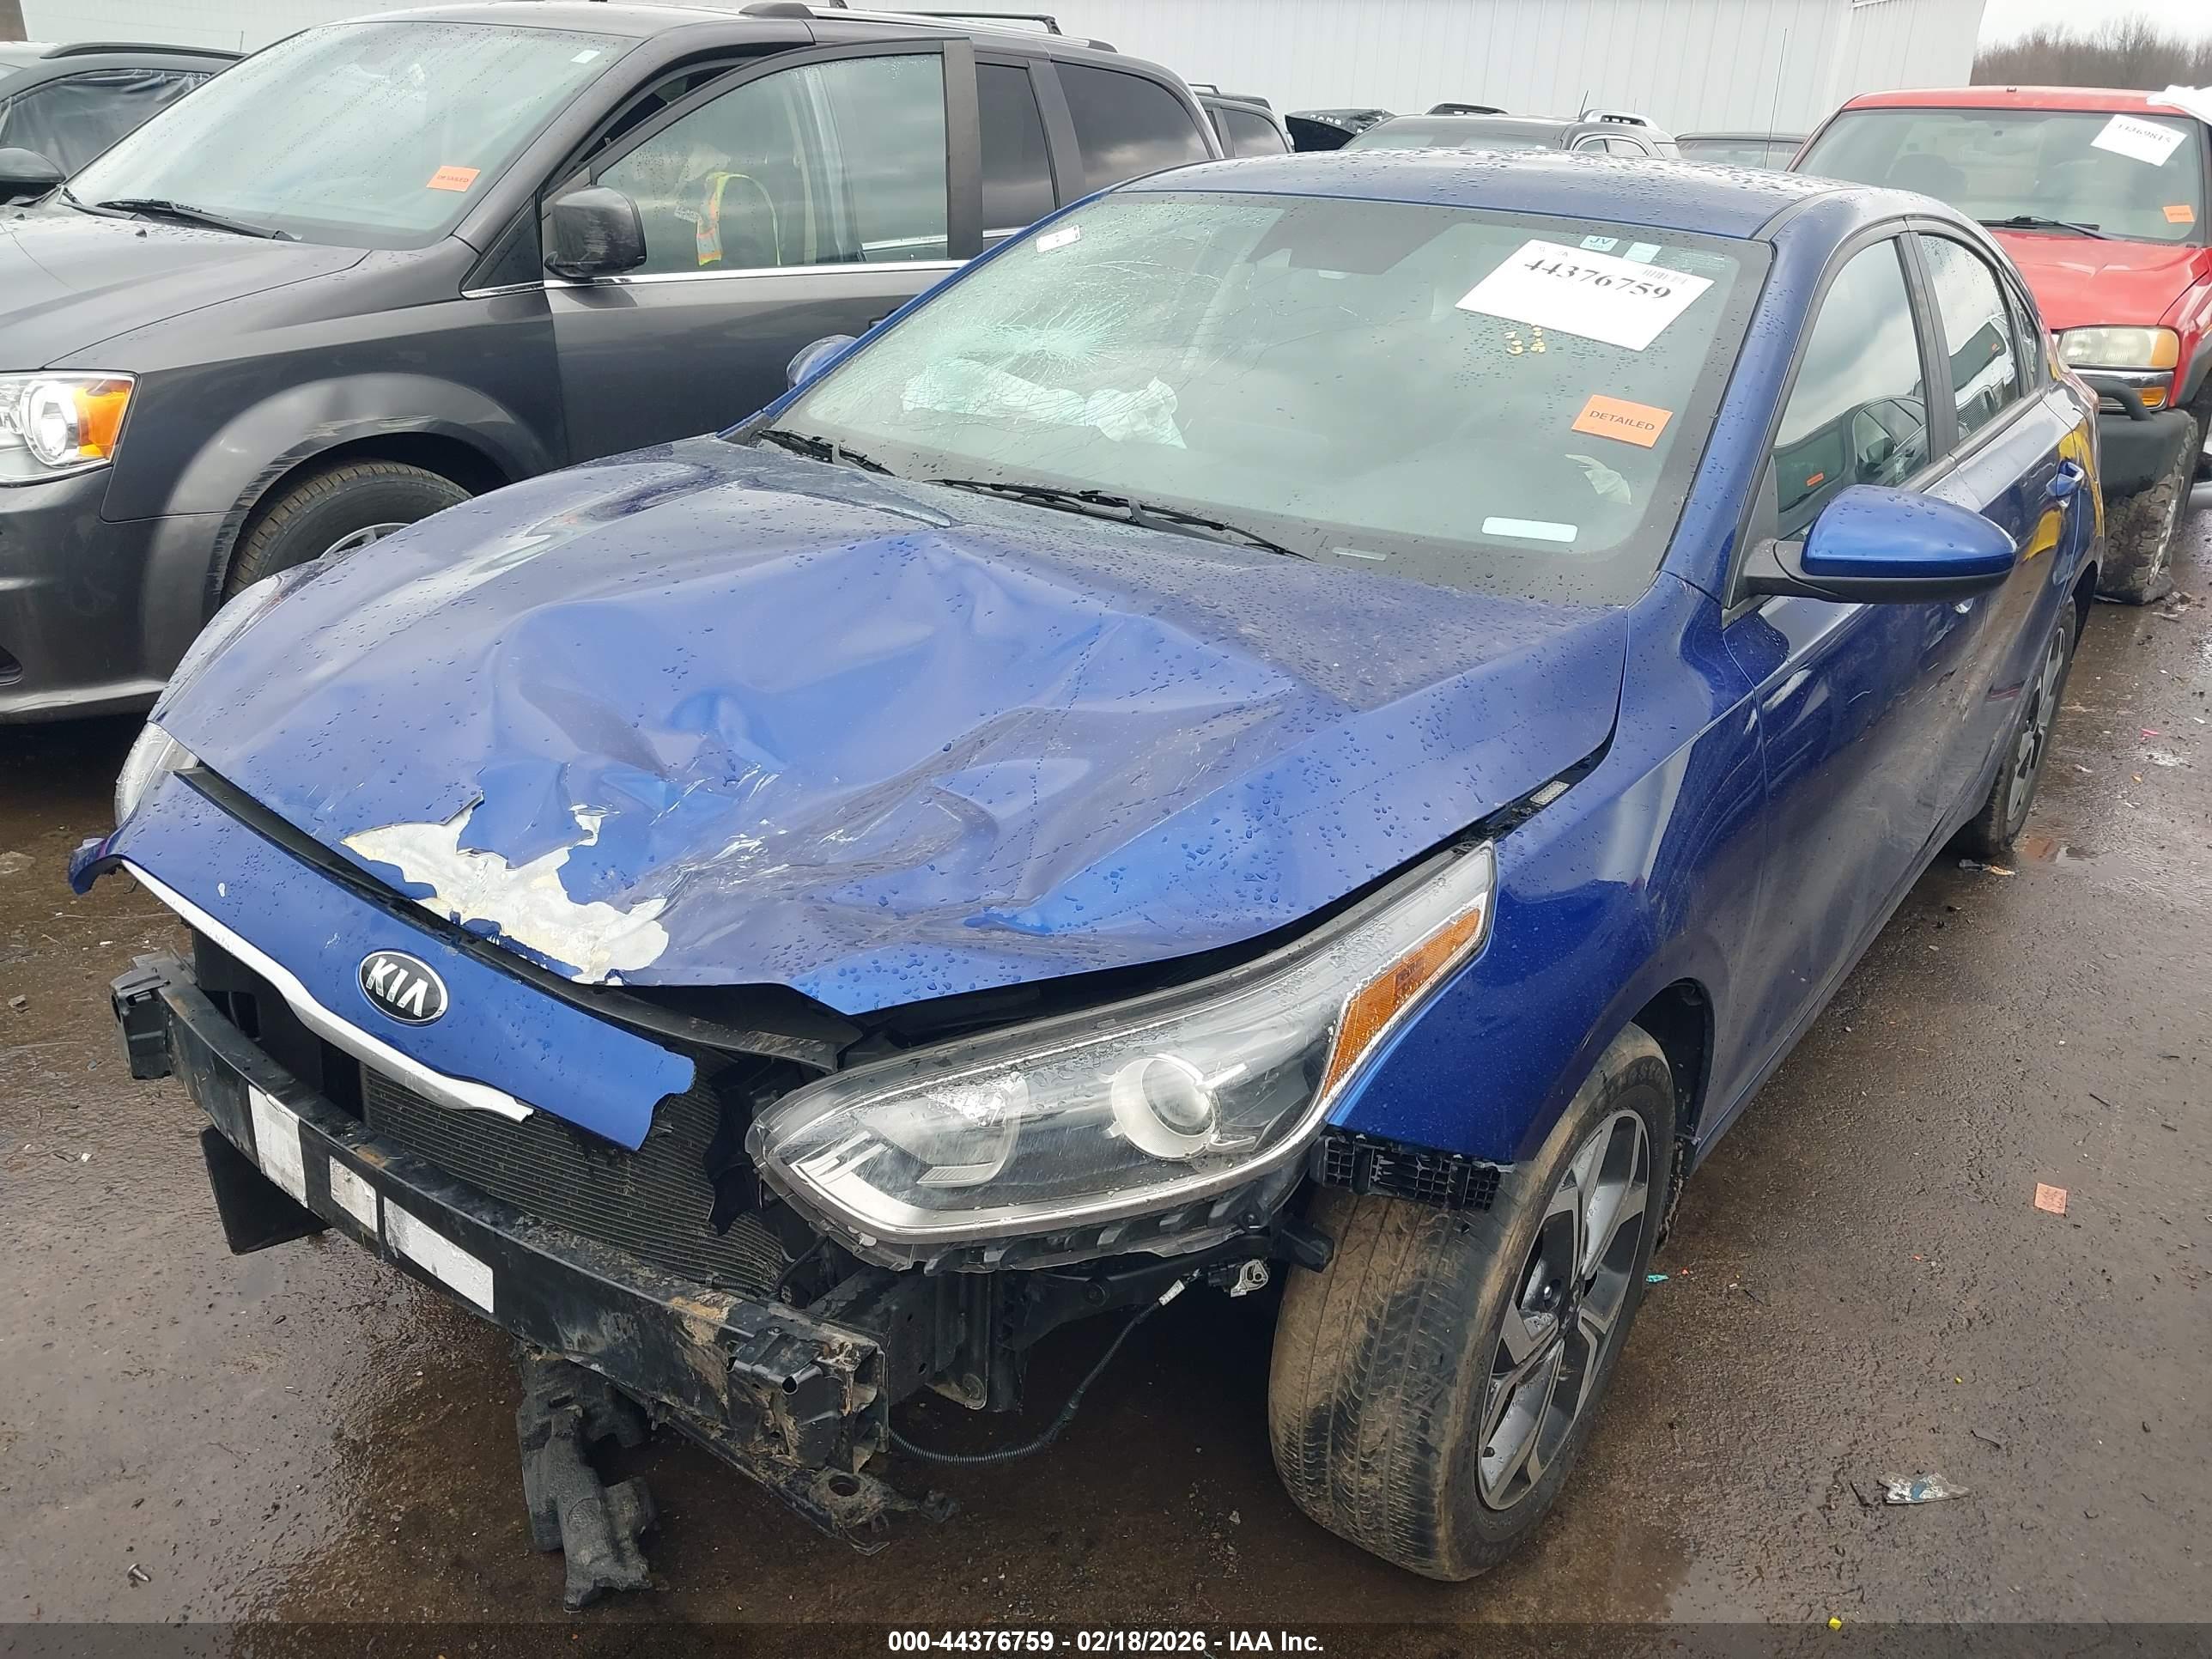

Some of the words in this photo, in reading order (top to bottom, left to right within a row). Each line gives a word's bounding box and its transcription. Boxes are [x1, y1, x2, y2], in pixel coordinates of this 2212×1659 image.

[1524, 258, 1671, 299] 44376759
[1589, 410, 1656, 431] DETAILED
[366, 957, 428, 1018] KIA
